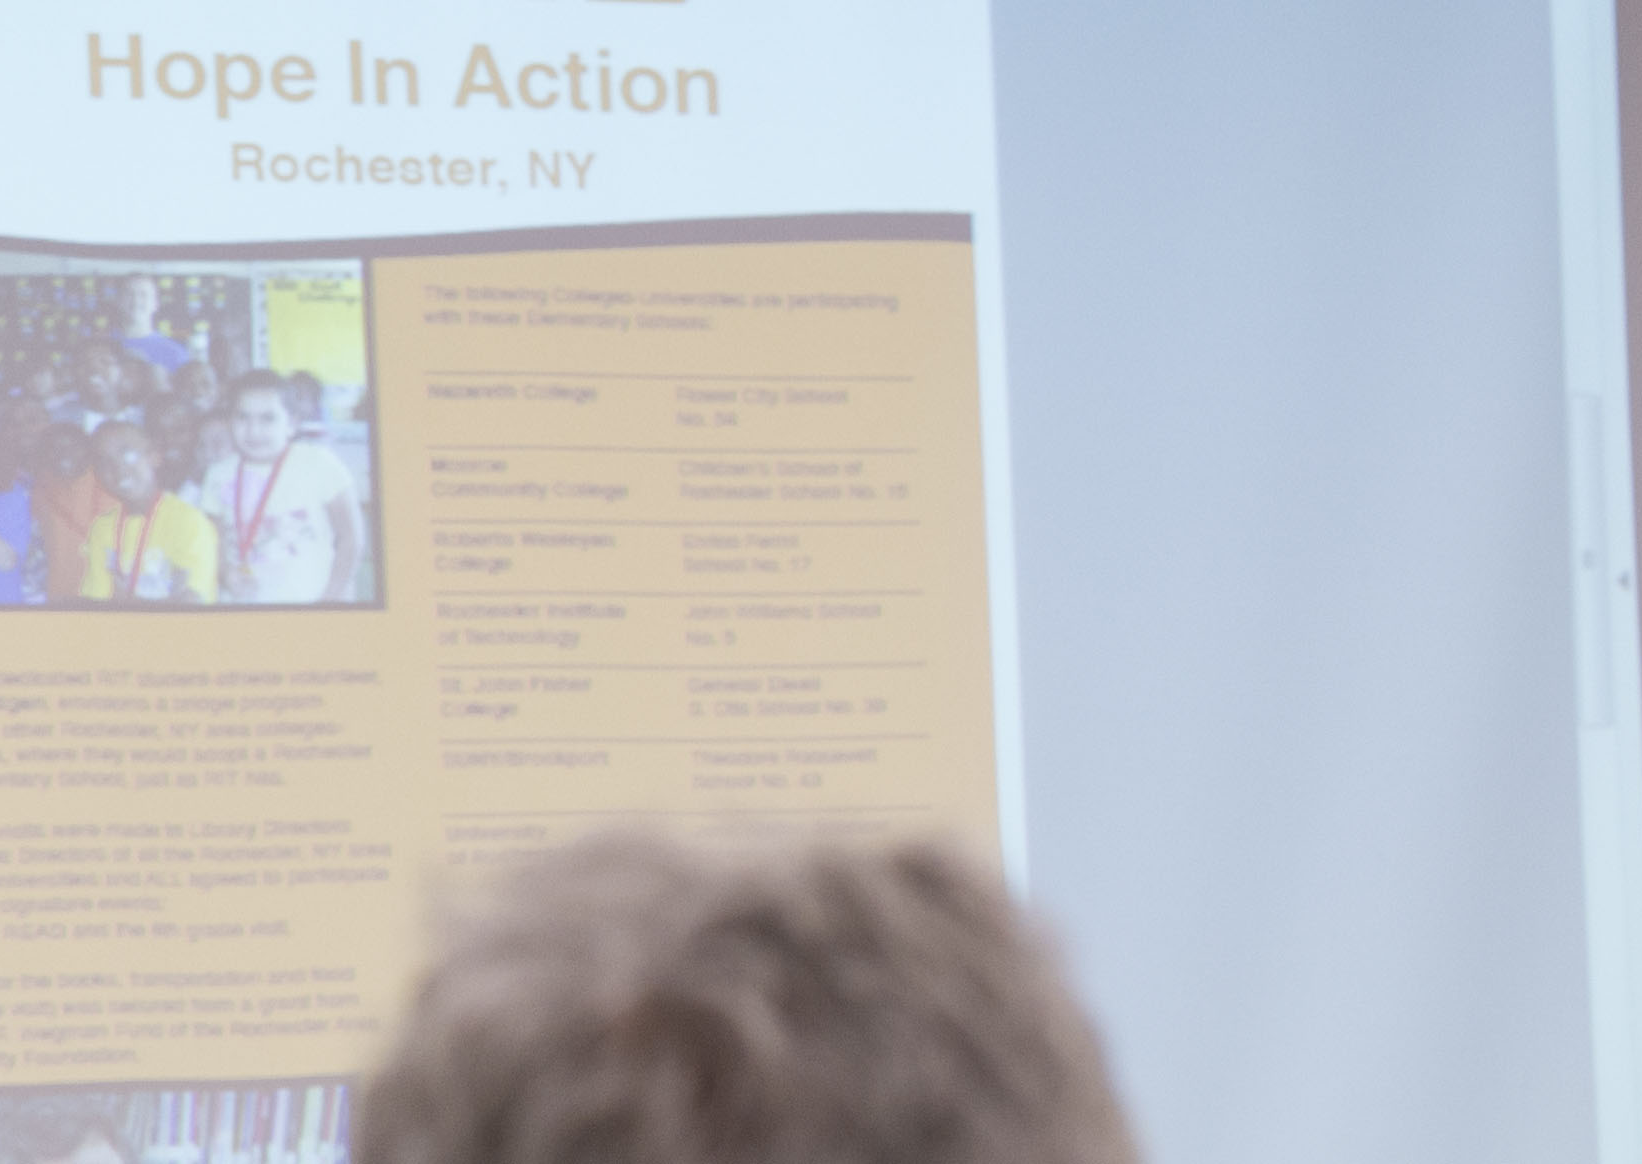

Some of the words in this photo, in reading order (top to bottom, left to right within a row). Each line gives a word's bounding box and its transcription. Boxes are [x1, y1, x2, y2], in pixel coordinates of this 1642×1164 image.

[85, 32, 317, 120] Hope
[348, 38, 421, 108] In
[453, 42, 721, 116] Action
[231, 142, 507, 194] Rochester,
[529, 150, 597, 190] NY
[524, 383, 598, 404] College
[743, 386, 778, 408] City
[785, 387, 849, 404] School
[553, 482, 629, 503] College
[434, 553, 513, 574] College
[465, 627, 582, 648] Technology
[440, 701, 519, 722] College
